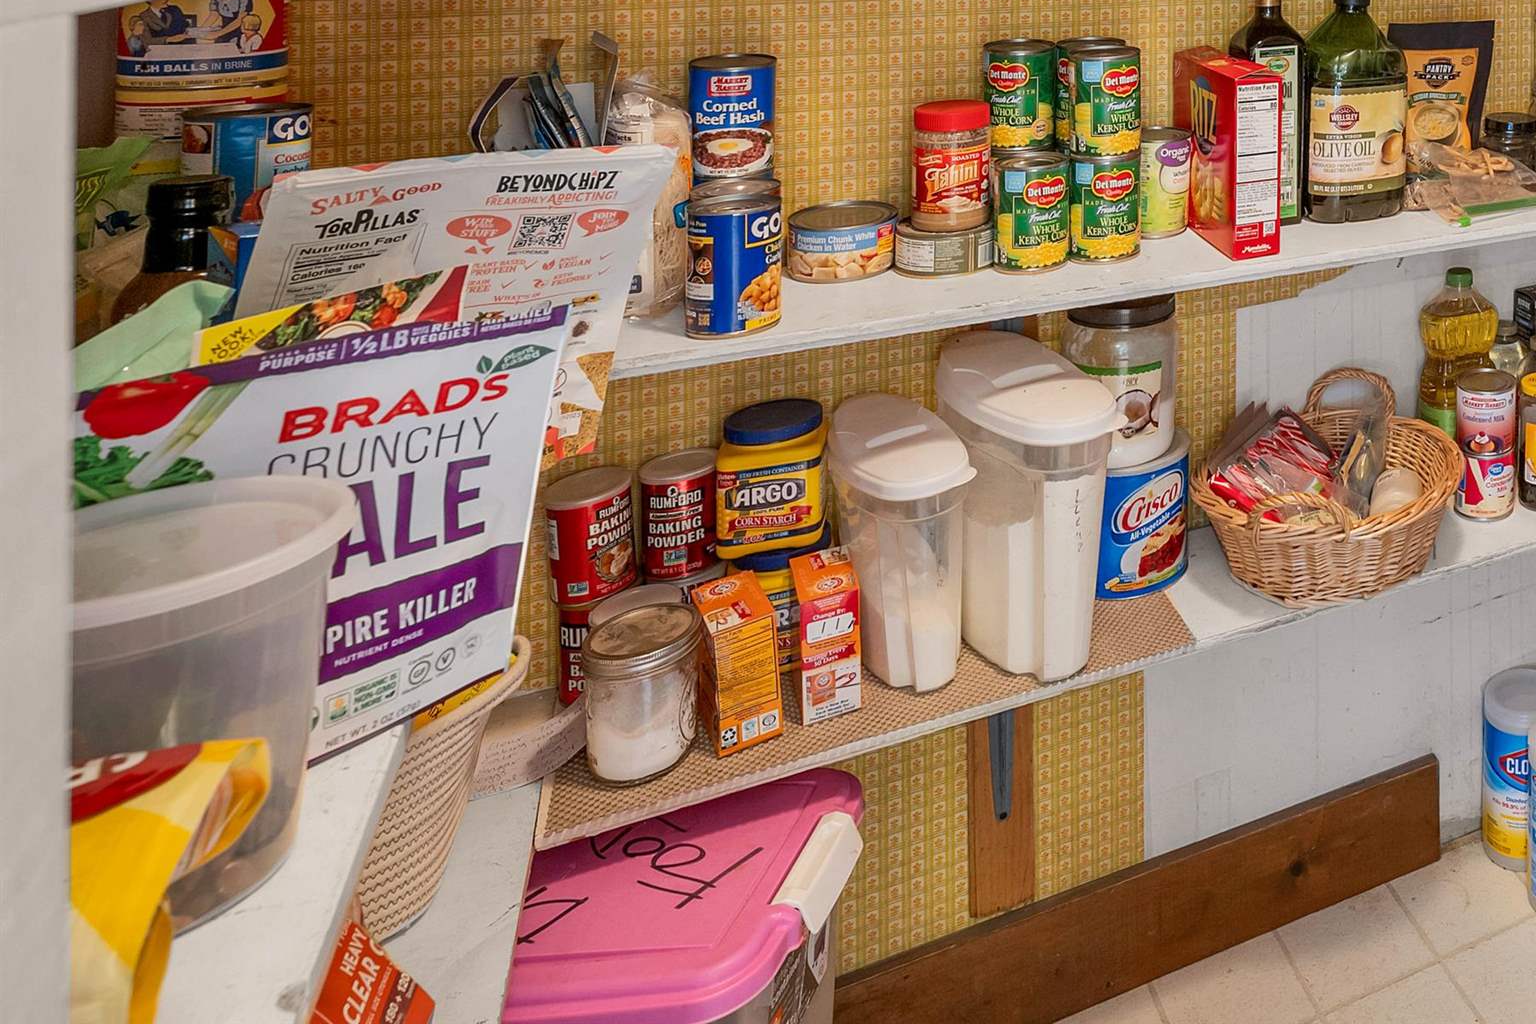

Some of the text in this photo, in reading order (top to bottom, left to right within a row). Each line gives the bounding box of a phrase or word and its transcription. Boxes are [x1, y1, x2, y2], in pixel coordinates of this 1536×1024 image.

[163, 59, 252, 73] BALLS IN BRINE
[1425, 63, 1454, 75] PANTRY
[990, 70, 1026, 79] Del Monte
[1105, 74, 1138, 86] Del Monte
[1238, 83, 1278, 93] Nutrition Facts
[702, 98, 757, 113] Corned
[993, 107, 1020, 117] WHOLE
[696, 111, 765, 126] Beef Hash
[1008, 115, 1033, 125] CORN
[1110, 112, 1135, 123] WHOLE
[1331, 112, 1359, 122] WELLSLEY
[1097, 122, 1127, 134] KERNEL
[1313, 140, 1375, 158] OLIVE OIL
[926, 162, 978, 193] Tahini
[1095, 177, 1132, 189] Del Monte
[310, 182, 442, 215] SALTY GOOD
[485, 190, 618, 206] FREAKISHLY ADDICTING!
[1027, 185, 1064, 200] Del Monte
[464, 217, 494, 227] WIN
[1100, 215, 1127, 227] WHOLE
[1032, 223, 1060, 235] WHOLE
[1087, 225, 1118, 237] KERNEL
[798, 230, 876, 245] Premium Chunk White
[1018, 234, 1053, 246] KERNEL
[300, 240, 370, 257] Nutrition
[834, 242, 856, 251] Water
[290, 266, 342, 282] Calories
[211, 326, 243, 354] NEW
[380, 327, 408, 351] LB
[411, 327, 471, 346] VEGGIES
[258, 348, 337, 372] PURPOSE
[501, 351, 542, 371] based
[503, 347, 534, 362] plant
[1463, 414, 1505, 423] Condensed Milk
[650, 489, 702, 509] RUMFORD
[735, 482, 798, 507] ARGO
[332, 455, 491, 578] ALE
[734, 513, 797, 527] CORN STARCH
[649, 516, 702, 535] BAKING
[1130, 513, 1171, 542] All-Vegetable
[648, 528, 705, 549] POWDER
[322, 578, 477, 656] PIRE KILLER
[812, 610, 834, 622] Change
[334, 628, 424, 668] NUTRIENT DENSE
[353, 681, 397, 704] NON-GMO
[325, 734, 346, 749] NET
[1506, 757, 1529, 775] CLO
[339, 927, 368, 977] HEAVY
[342, 955, 381, 1024] CLEAR
